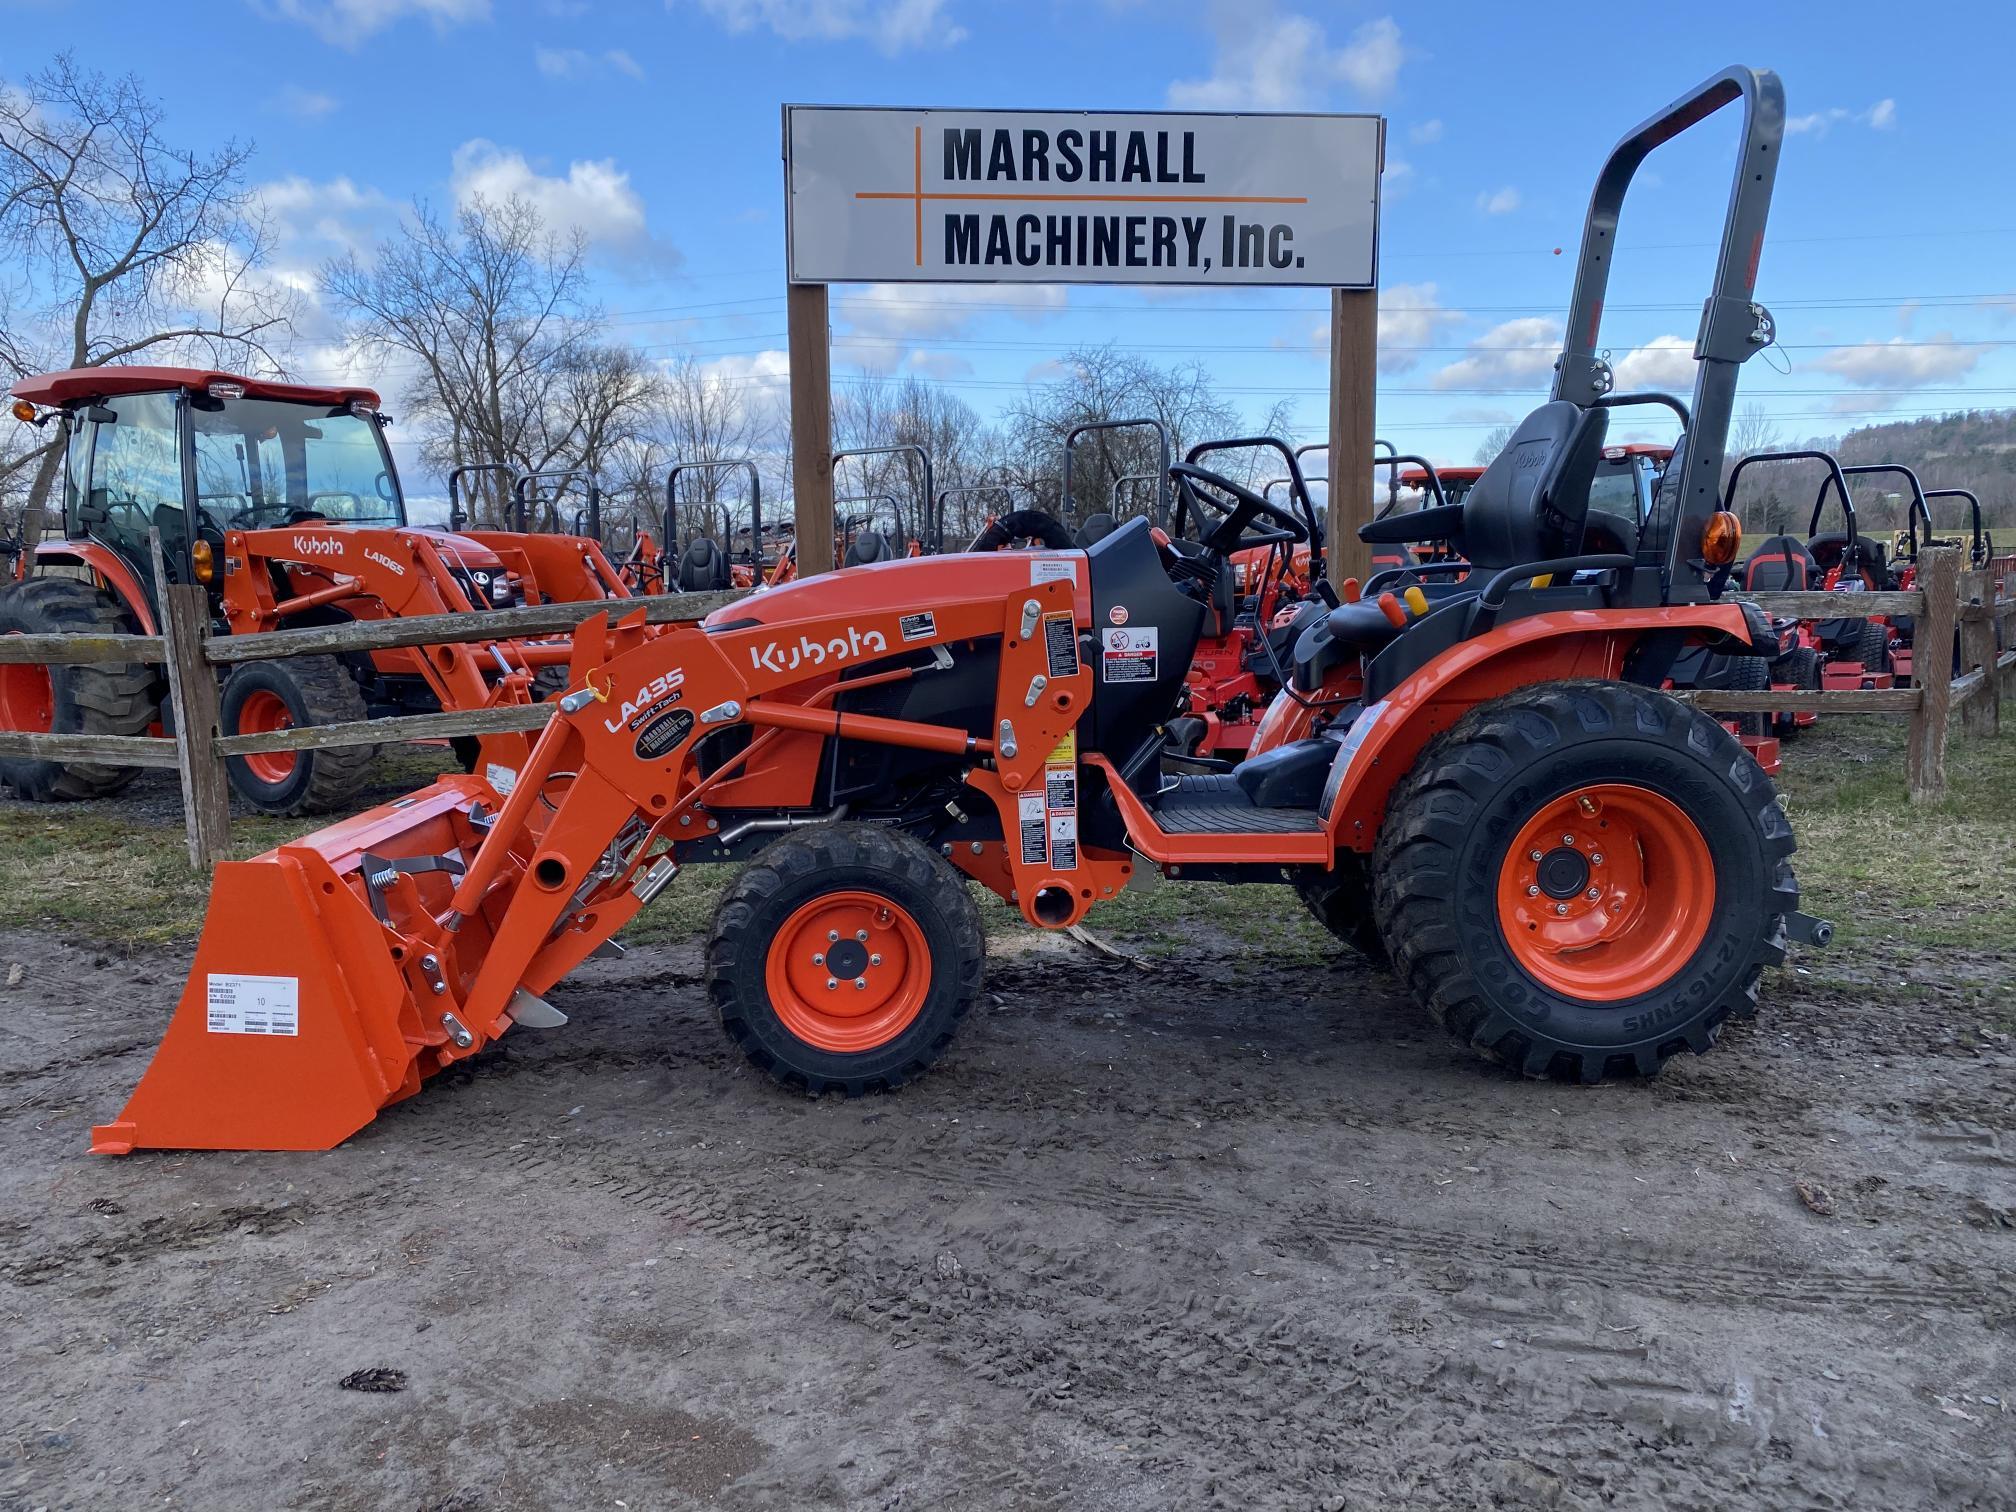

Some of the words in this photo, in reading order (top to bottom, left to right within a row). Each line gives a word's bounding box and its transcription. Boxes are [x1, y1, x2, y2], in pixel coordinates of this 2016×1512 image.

[943, 128, 1206, 184] MARSHALL
[944, 213, 1211, 275] MACHINERY,
[1222, 214, 1305, 269] Inc.
[293, 535, 344, 555] Kubota
[363, 547, 405, 576] LA1065
[750, 626, 887, 673] Kubota
[604, 666, 685, 734] LA435
[631, 692, 681, 730] Swift-Tach
[643, 716, 675, 743] MARSHALL
